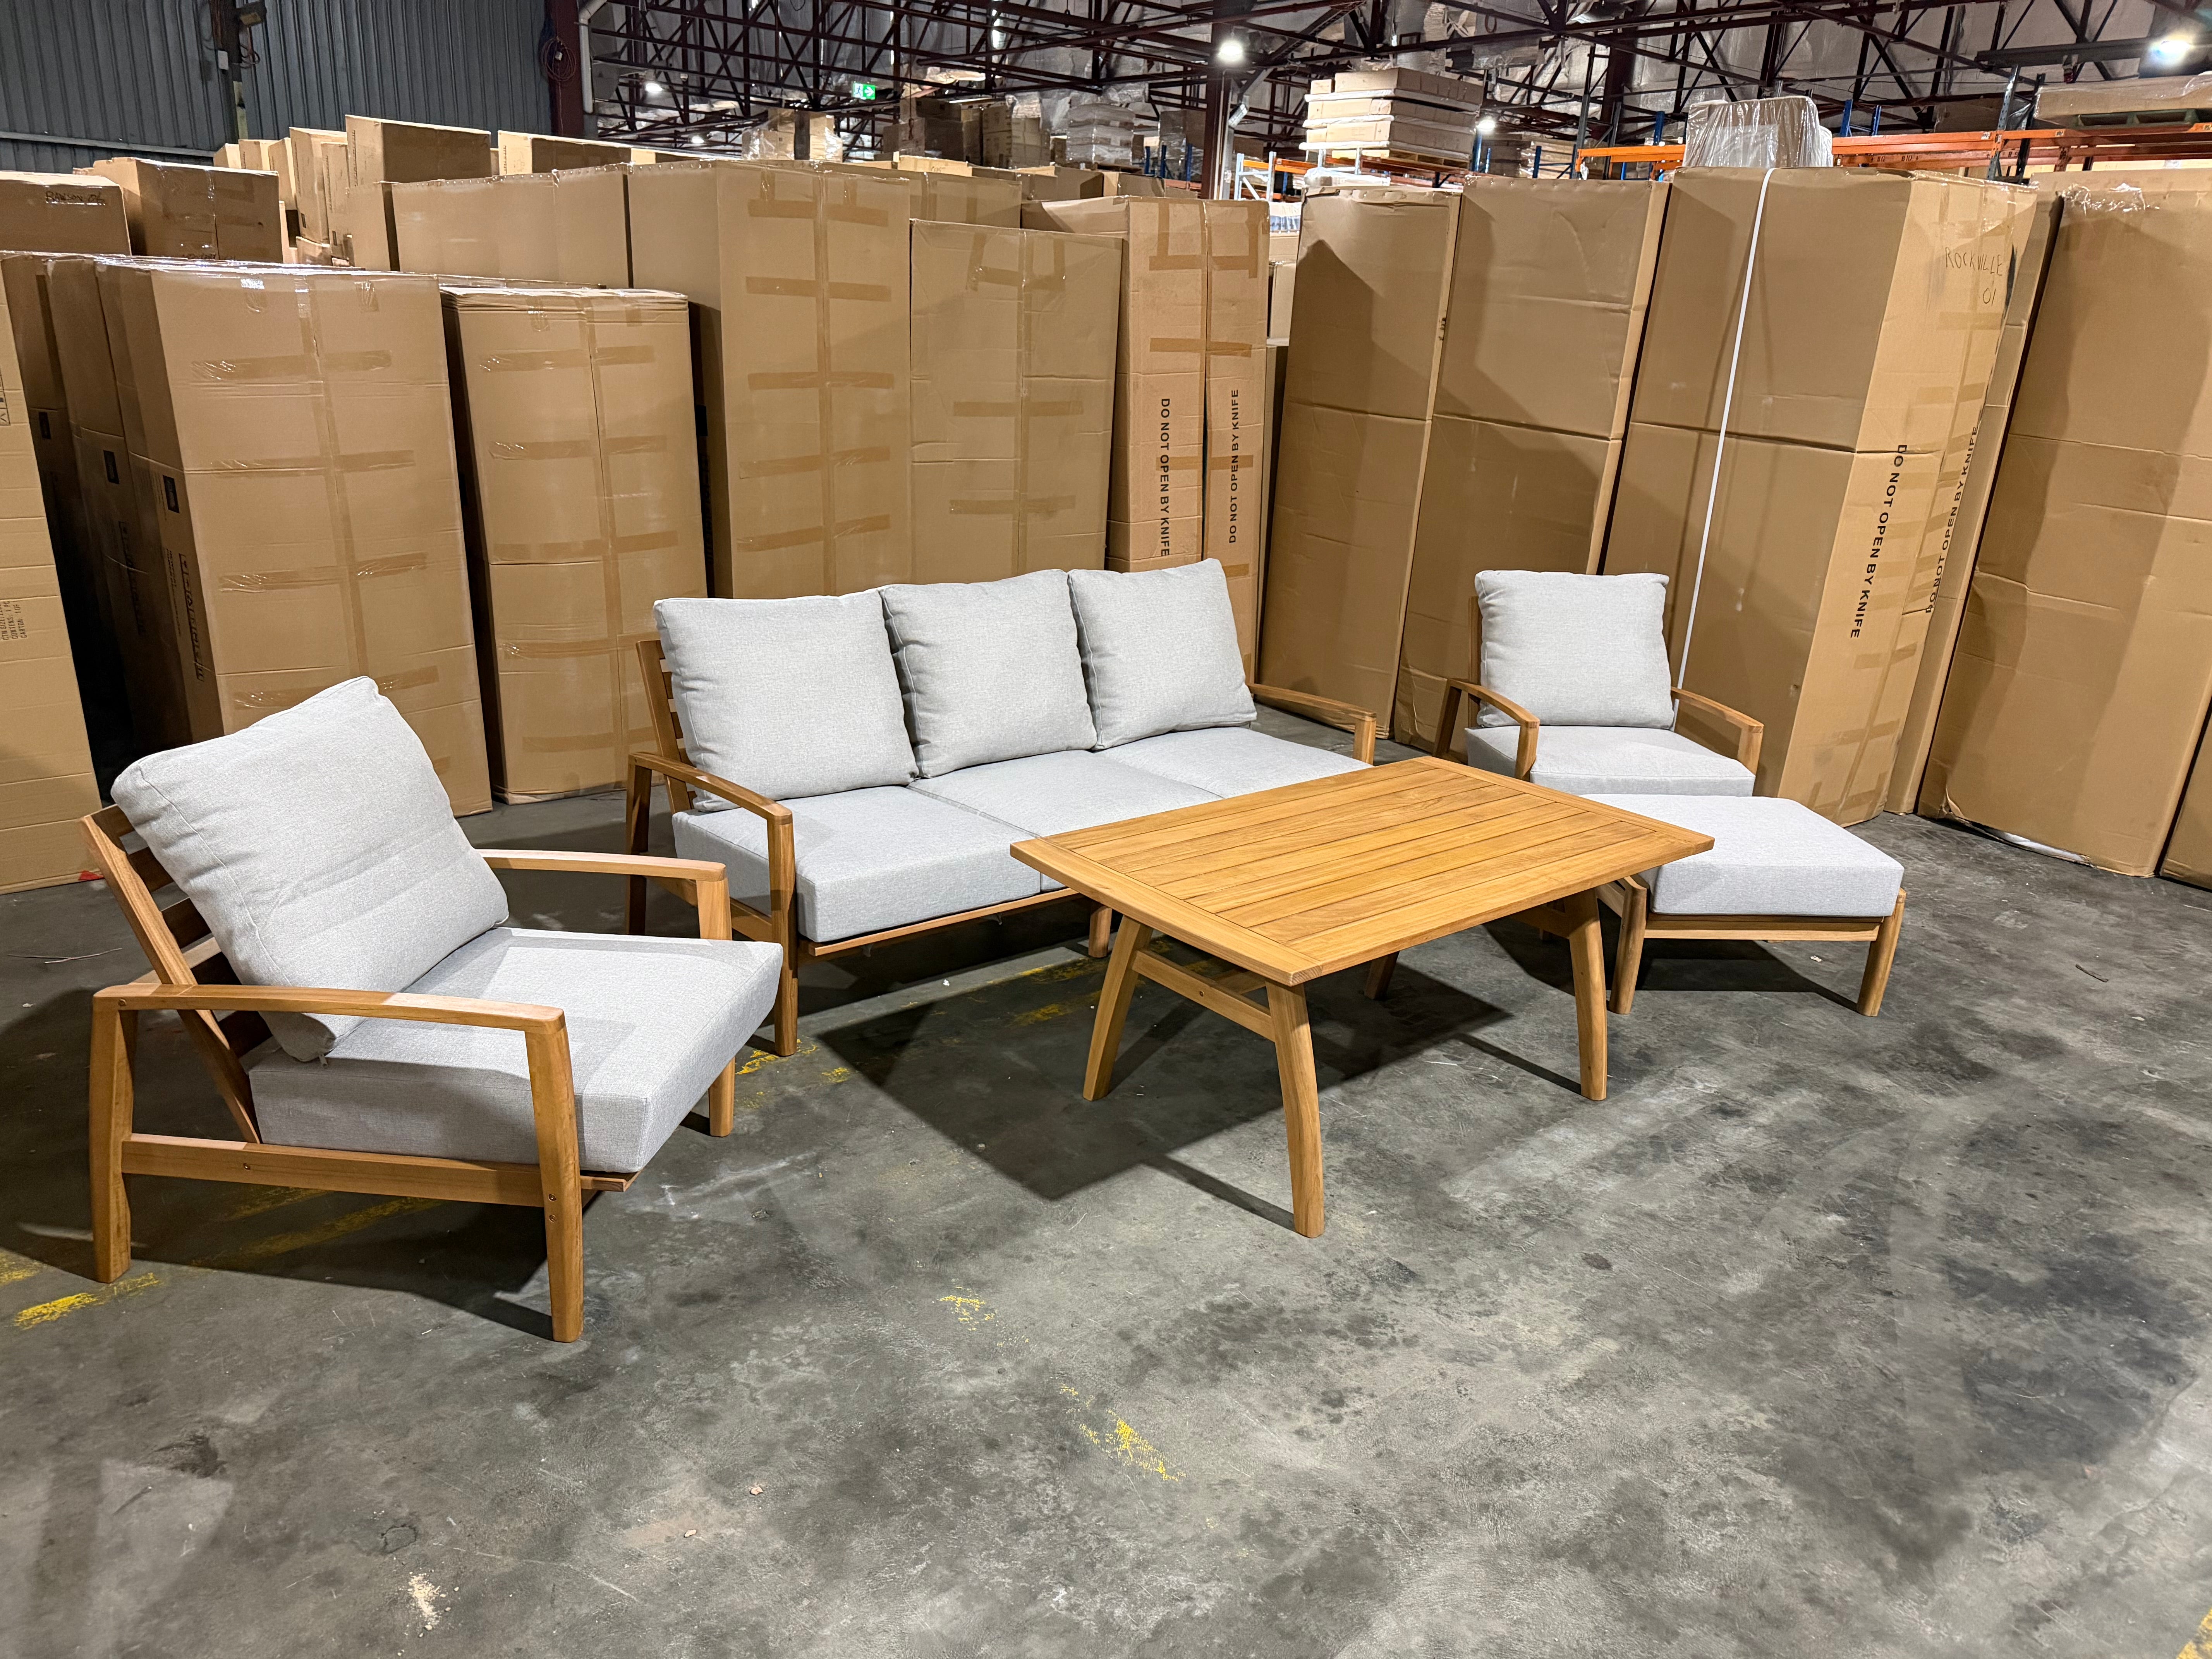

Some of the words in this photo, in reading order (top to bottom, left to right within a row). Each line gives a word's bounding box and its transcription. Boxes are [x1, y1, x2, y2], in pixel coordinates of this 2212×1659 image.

[1945, 247, 2003, 276] ROCKVILLE
[1983, 287, 1996, 306] 01
[1161, 398, 1170, 418] DO
[1231, 389, 1240, 430] KNIFE
[1160, 422, 1170, 450] NOT
[1231, 434, 1239, 451] BY
[1894, 445, 1908, 467] DO
[1160, 455, 1169, 492] OPEN
[1231, 455, 1239, 491] OPEN
[1883, 472, 1900, 508] NOT
[1160, 496, 1169, 514] BY
[1925, 592, 1936, 613] DO
[1933, 555, 1945, 587] NOT
[1942, 507, 1958, 550] OPEN
[1954, 480, 1964, 501] BY
[1961, 426, 1978, 475] KNIFE
[1160, 517, 1170, 557] KNIFE
[1229, 526, 1237, 543] DO
[1870, 512, 1889, 558] OPEN
[1864, 563, 1877, 585] BY
[1850, 590, 1870, 638] KNIFE
